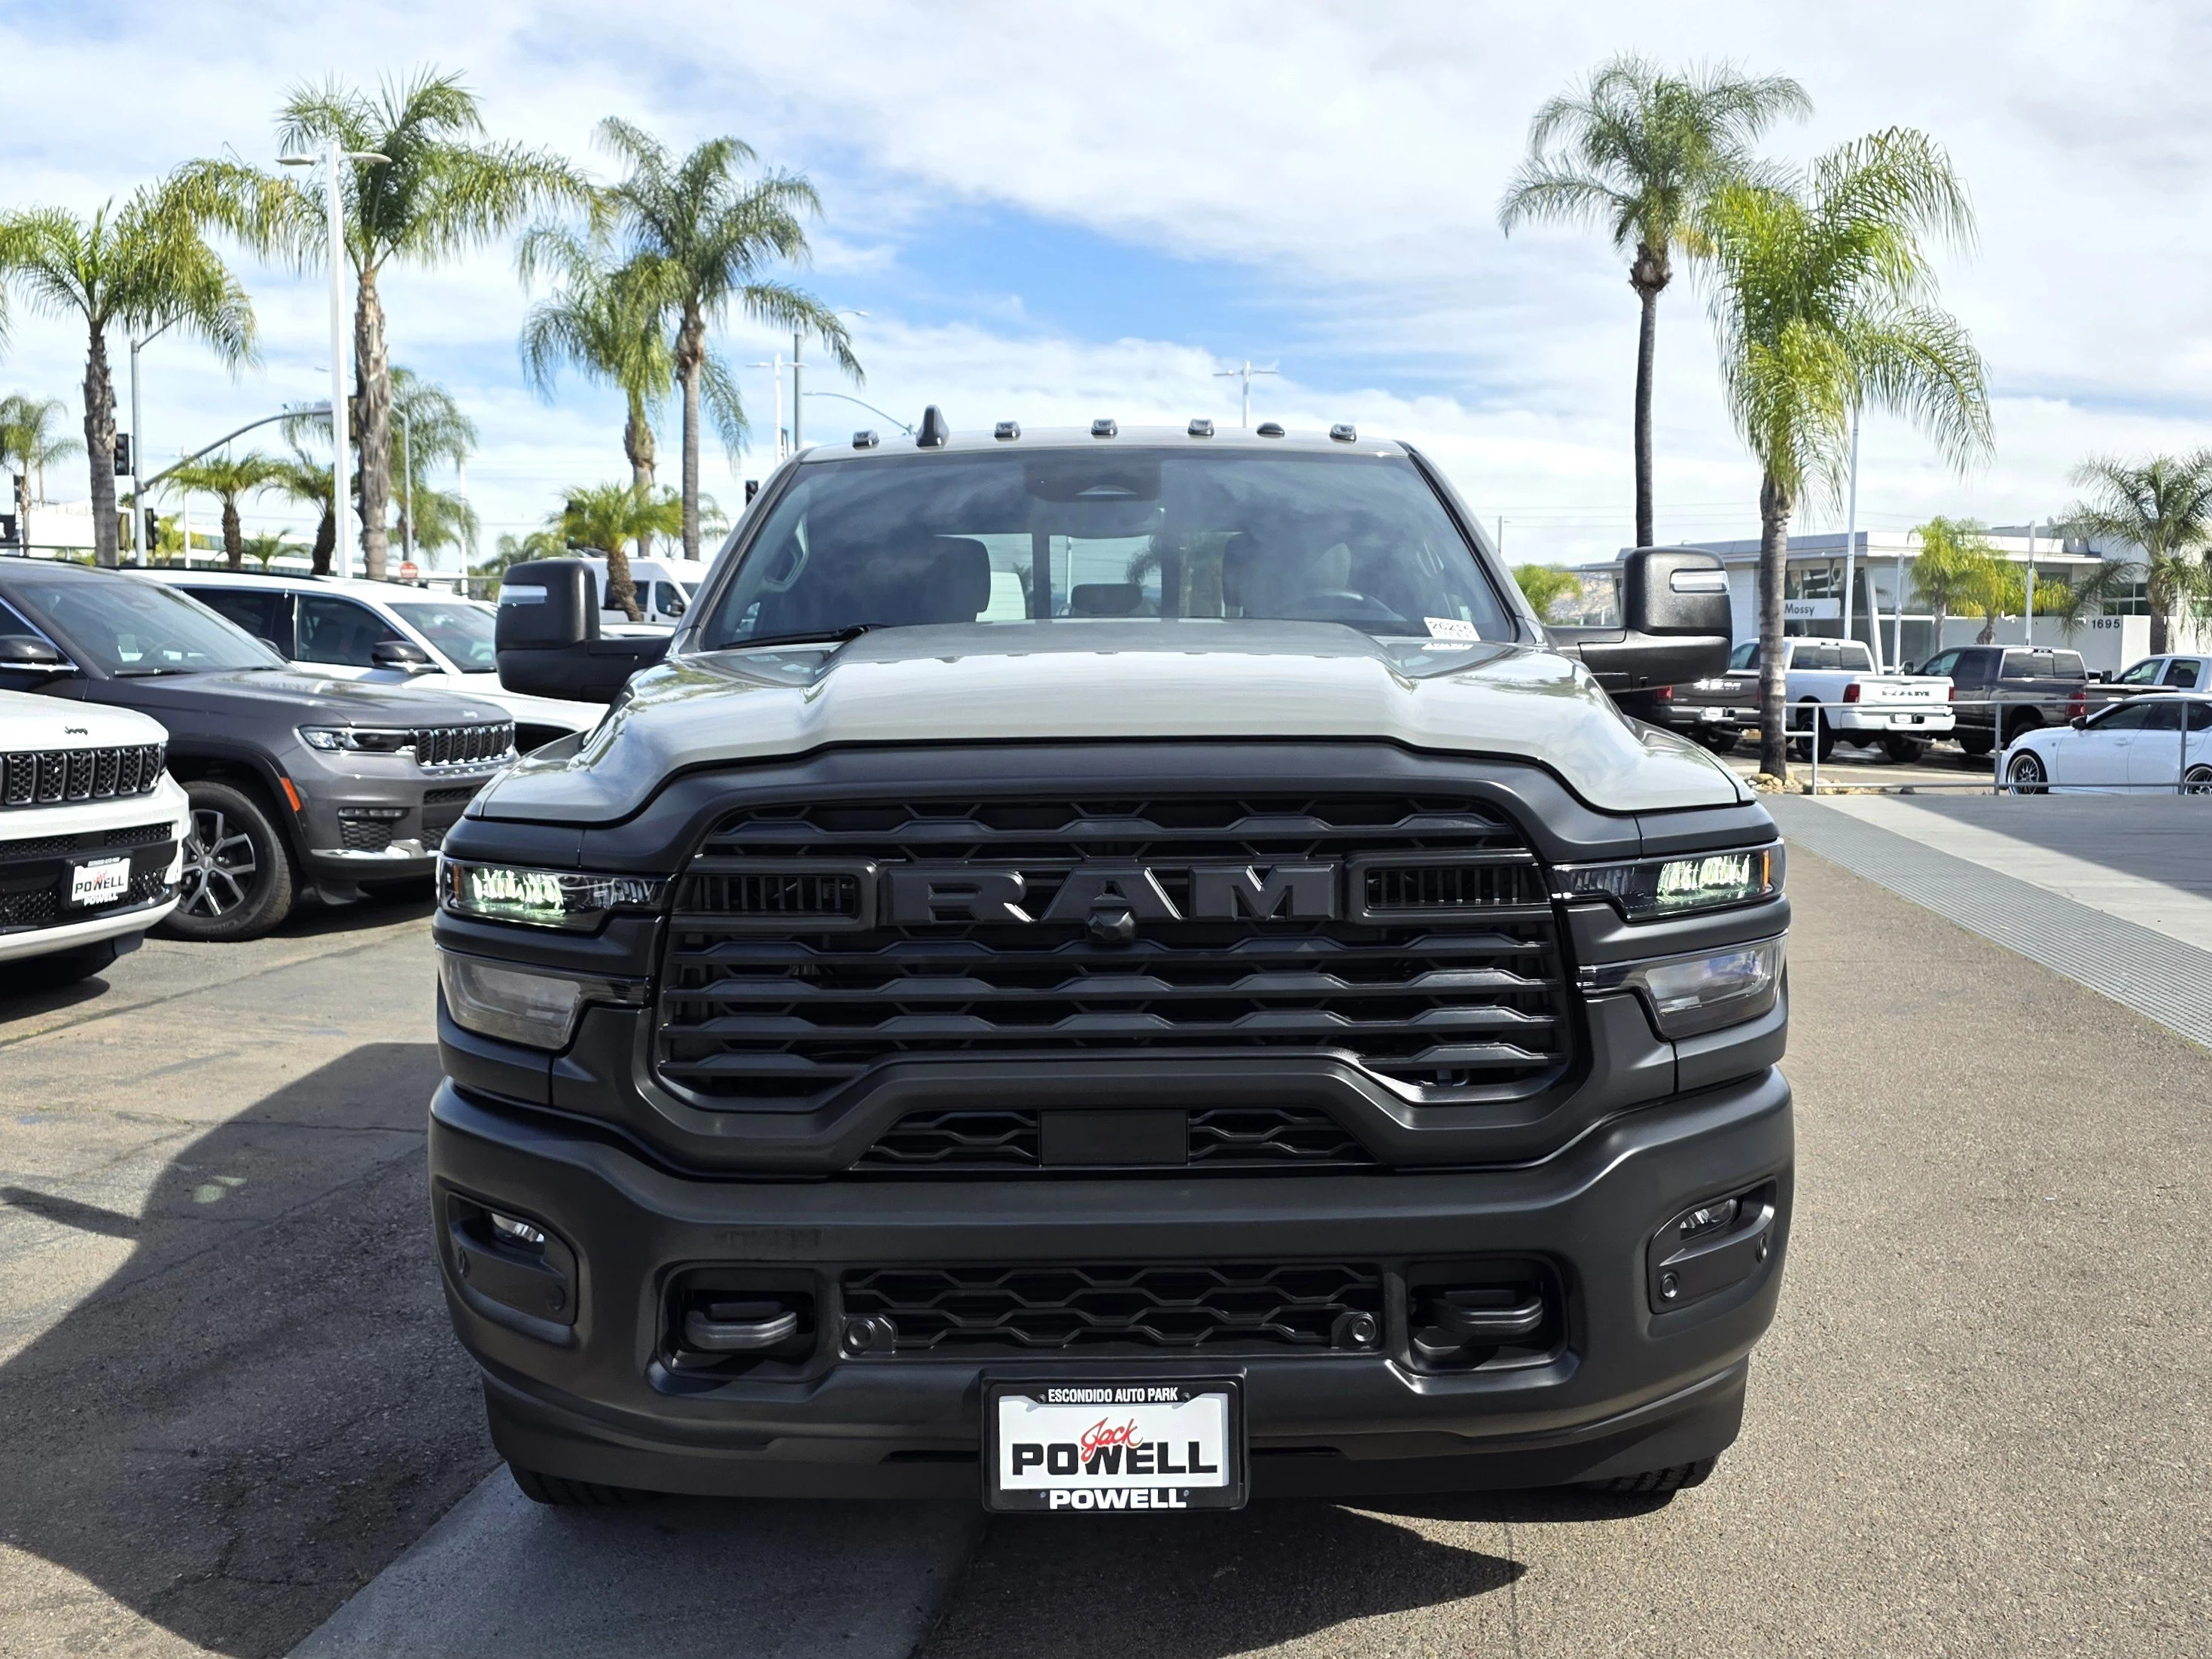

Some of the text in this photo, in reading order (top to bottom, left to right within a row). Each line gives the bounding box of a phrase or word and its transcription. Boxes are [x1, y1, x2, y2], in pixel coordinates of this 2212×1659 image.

[1784, 603, 1814, 616] Mossy
[2091, 619, 2120, 630] 1695
[75, 875, 124, 894] POWELL
[887, 866, 1336, 923] RAM
[1047, 1386, 1178, 1403] ESCONDIDO AUTO PARK
[1080, 1417, 1144, 1462] Jack
[1012, 1441, 1218, 1476] POWELL
[1050, 1488, 1187, 1510] POWELL
